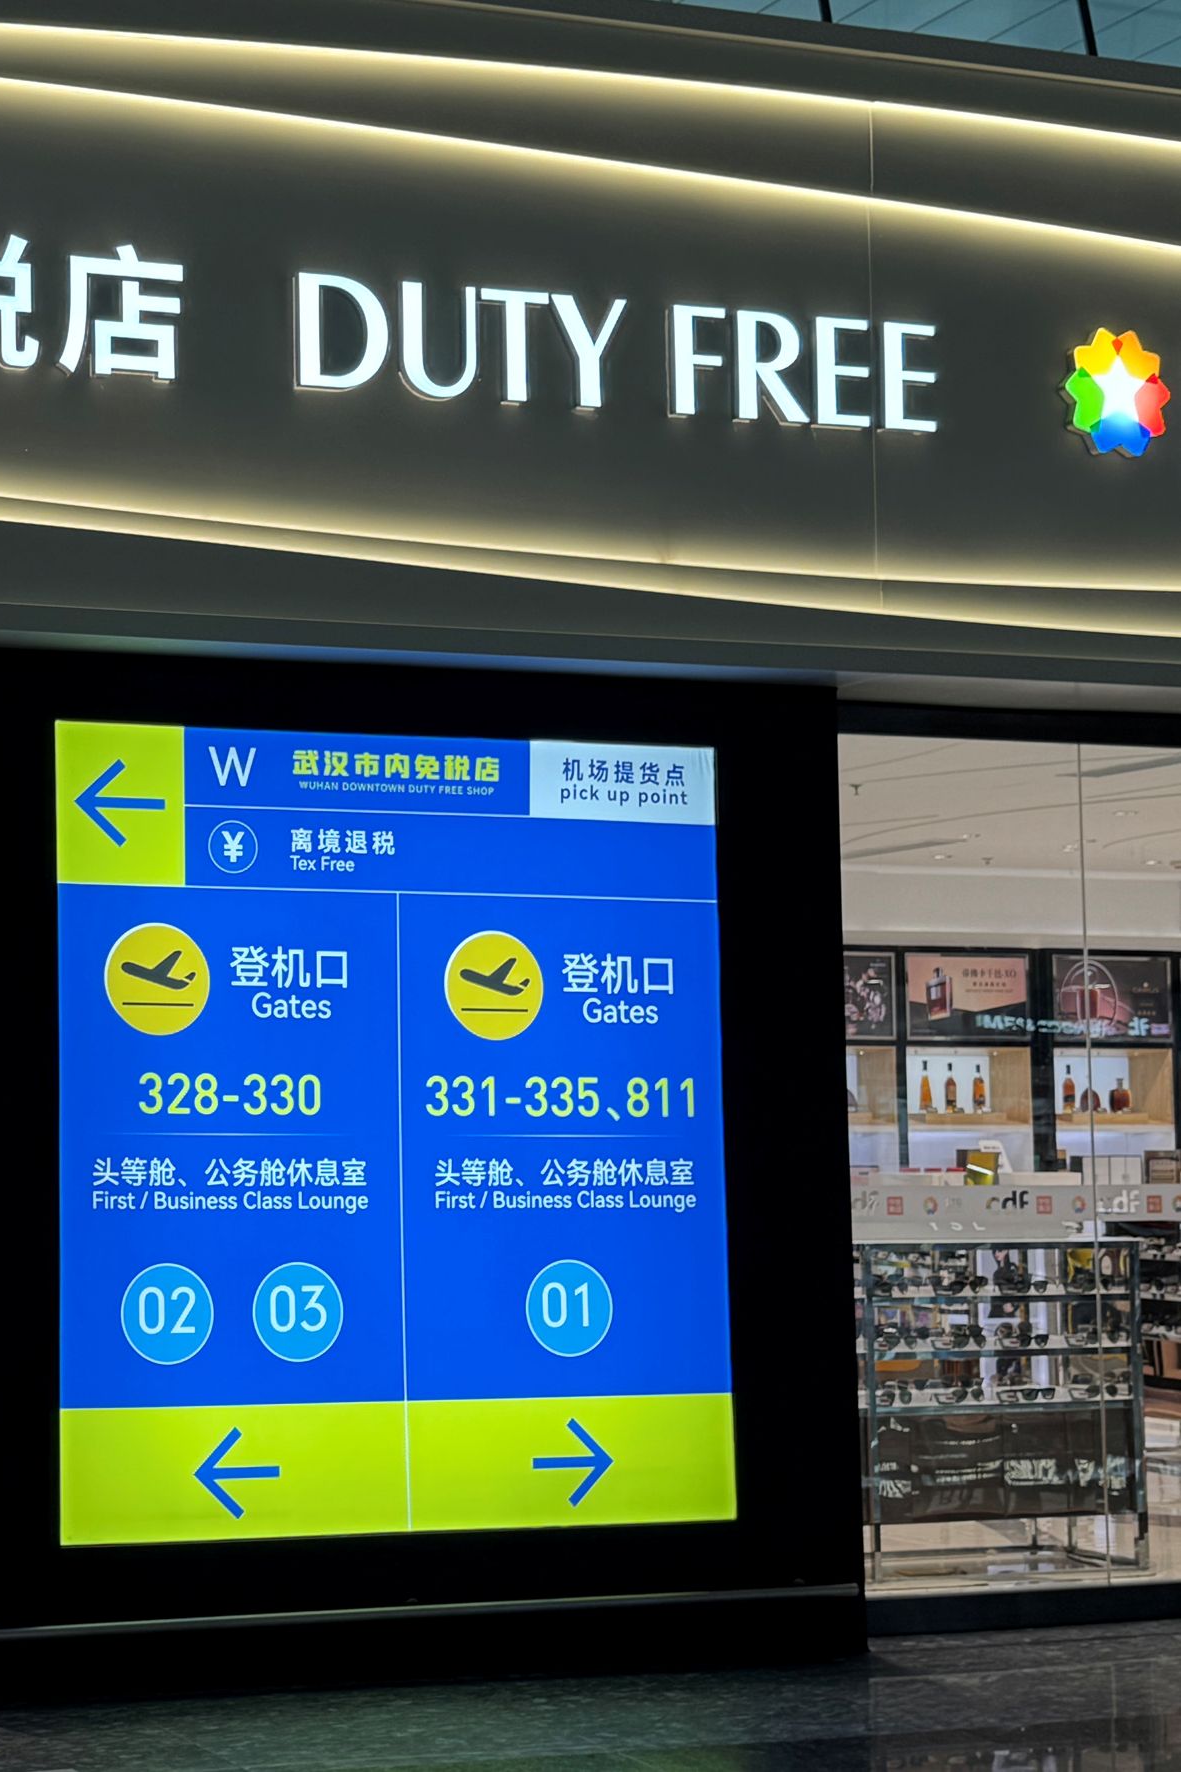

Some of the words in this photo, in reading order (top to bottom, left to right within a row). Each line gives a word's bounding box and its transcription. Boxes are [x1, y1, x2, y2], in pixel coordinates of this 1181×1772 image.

[294, 271, 627, 410] DUTY
[668, 303, 938, 433] FREE
[208, 746, 257, 788] W
[292, 749, 500, 783] 武汉市内免税店
[562, 757, 686, 787] 机场提货点
[298, 780, 339, 792] WUHAN
[342, 782, 405, 793] DOWNTOWN
[408, 783, 435, 795] DUTY
[438, 785, 464, 796] FREE
[466, 786, 495, 797] SHOP
[560, 784, 600, 804] pick
[607, 790, 630, 806] up
[638, 788, 688, 807] point
[290, 827, 396, 855] 离境退税
[290, 855, 316, 872] Tex
[320, 856, 355, 872] Free
[229, 945, 348, 989] 登机口
[561, 953, 675, 995] 登机口
[251, 991, 332, 1019] Gates
[582, 997, 659, 1024] Gates
[138, 1071, 322, 1116] 328-330
[92, 1156, 368, 1188] 头等舱、公务舱休息室
[434, 1158, 695, 1188] 头等舱、公务舱休息室
[92, 1191, 136, 1210] First
[153, 1191, 238, 1210] Business
[243, 1190, 293, 1210] Class
[298, 1192, 369, 1214] Lounge
[435, 1190, 476, 1209] First
[493, 1190, 572, 1209] Business
[577, 1190, 624, 1209] Class
[629, 1191, 697, 1213] Lounge
[138, 1286, 196, 1335] 02
[269, 1284, 328, 1333] 03
[542, 1281, 590, 1329] 01
